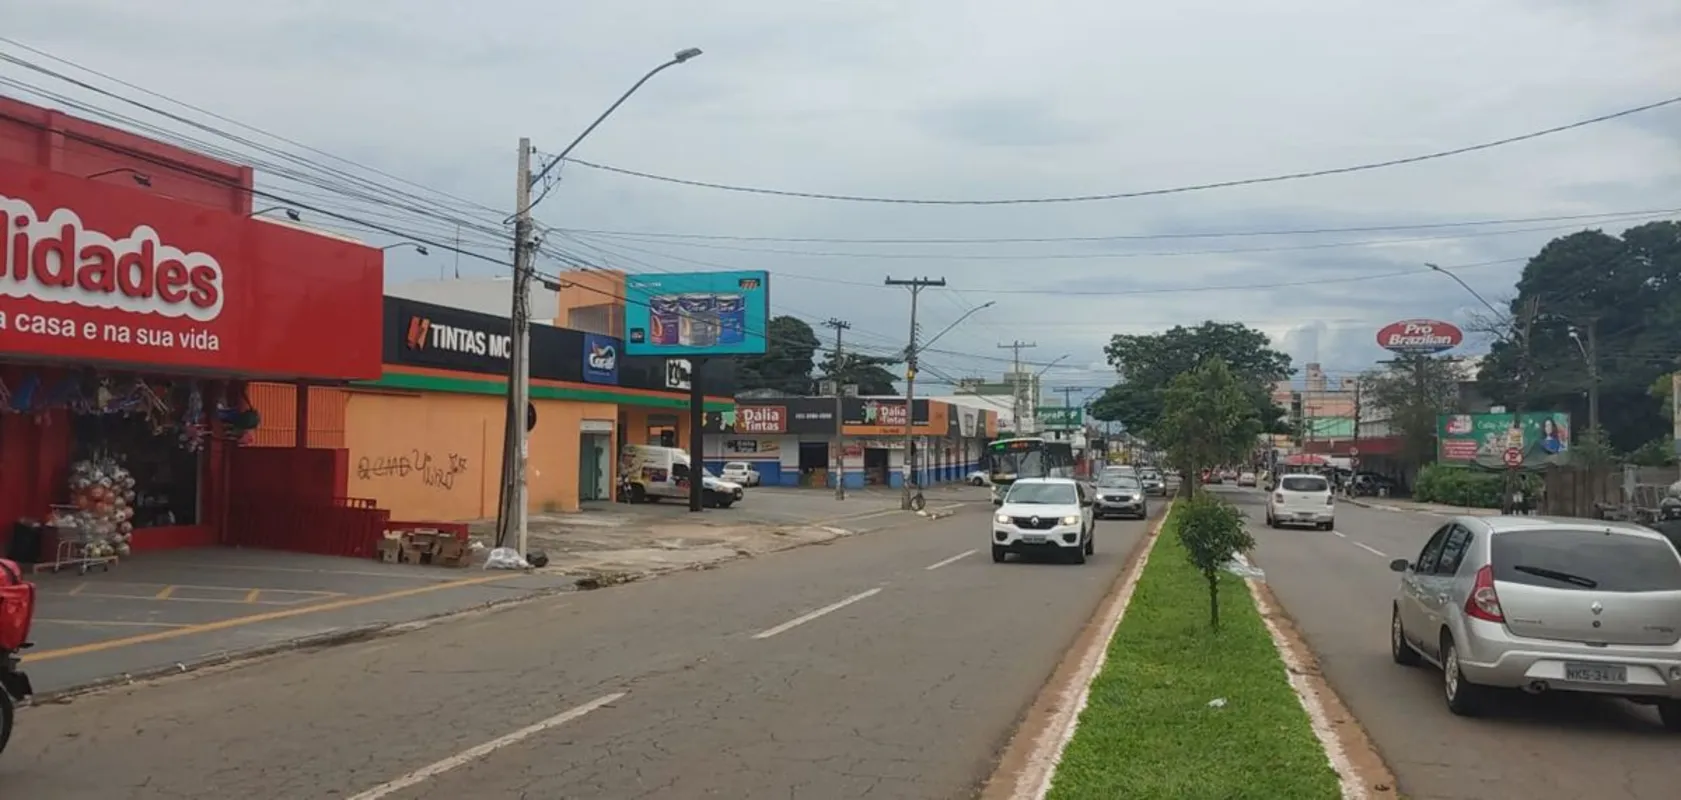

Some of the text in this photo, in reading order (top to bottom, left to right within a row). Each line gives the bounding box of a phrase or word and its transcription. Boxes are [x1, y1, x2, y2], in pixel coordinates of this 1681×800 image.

[15, 312, 76, 338] casa
[83, 321, 98, 340] e
[104, 324, 131, 344] na
[136, 325, 174, 348] sua
[179, 326, 220, 351] vida
[1404, 323, 1434, 335] Pro
[430, 323, 487, 356] TINTAS
[1388, 333, 1453, 346] Brazilian
[743, 407, 780, 422] Dália
[880, 404, 907, 417] Dália
[745, 420, 780, 432] Tintas
[881, 414, 907, 425] Tintas
